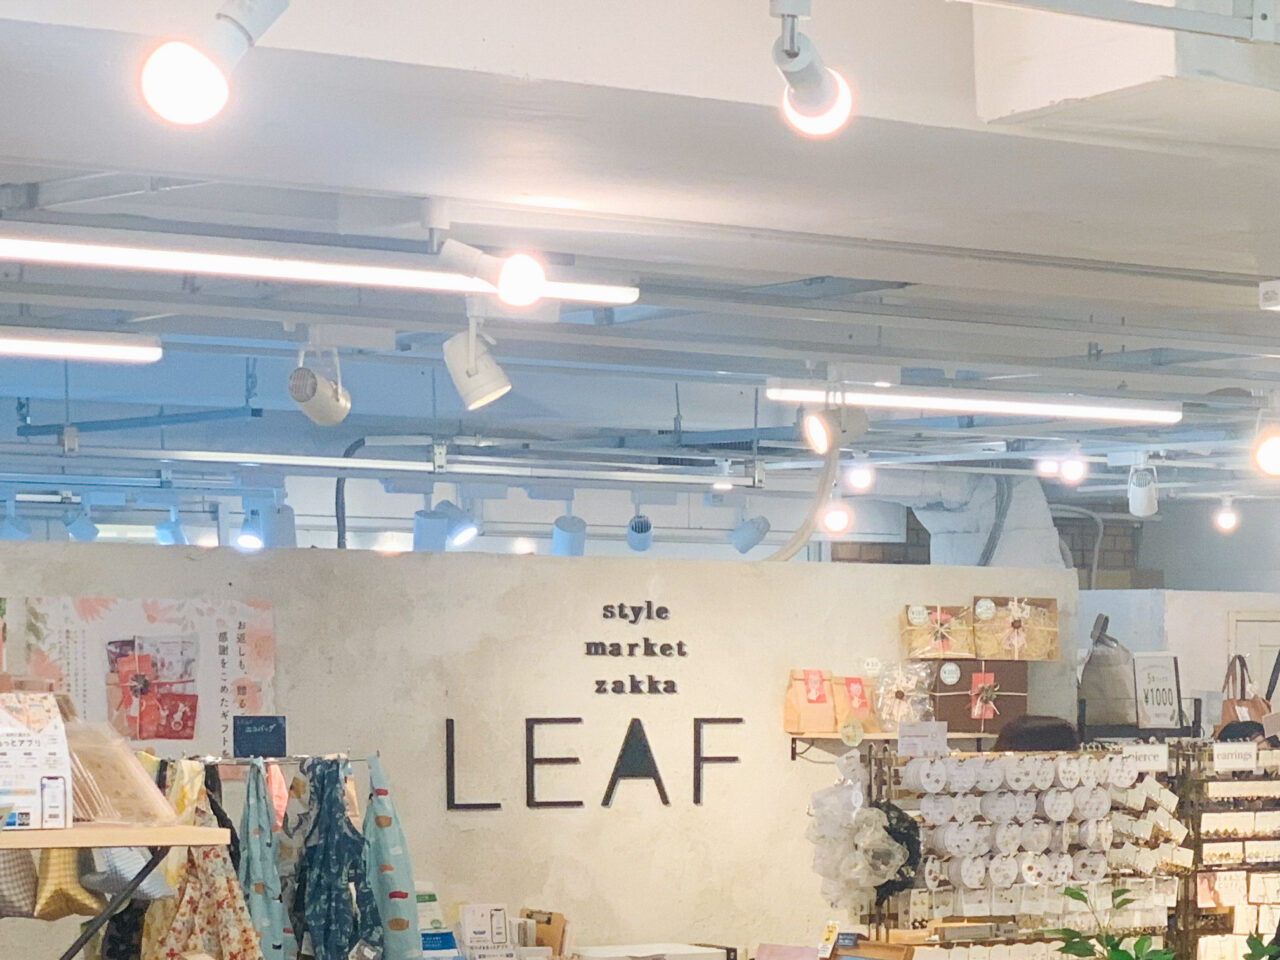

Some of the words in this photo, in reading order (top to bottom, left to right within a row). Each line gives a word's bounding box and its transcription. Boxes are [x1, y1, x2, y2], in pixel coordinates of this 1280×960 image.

[602, 600, 669, 623] style
[585, 637, 688, 657] market
[595, 675, 679, 694] zakka
[1143, 687, 1174, 707] ¥1000
[446, 717, 744, 811] LEAF
[1216, 751, 1253, 763] earrings
